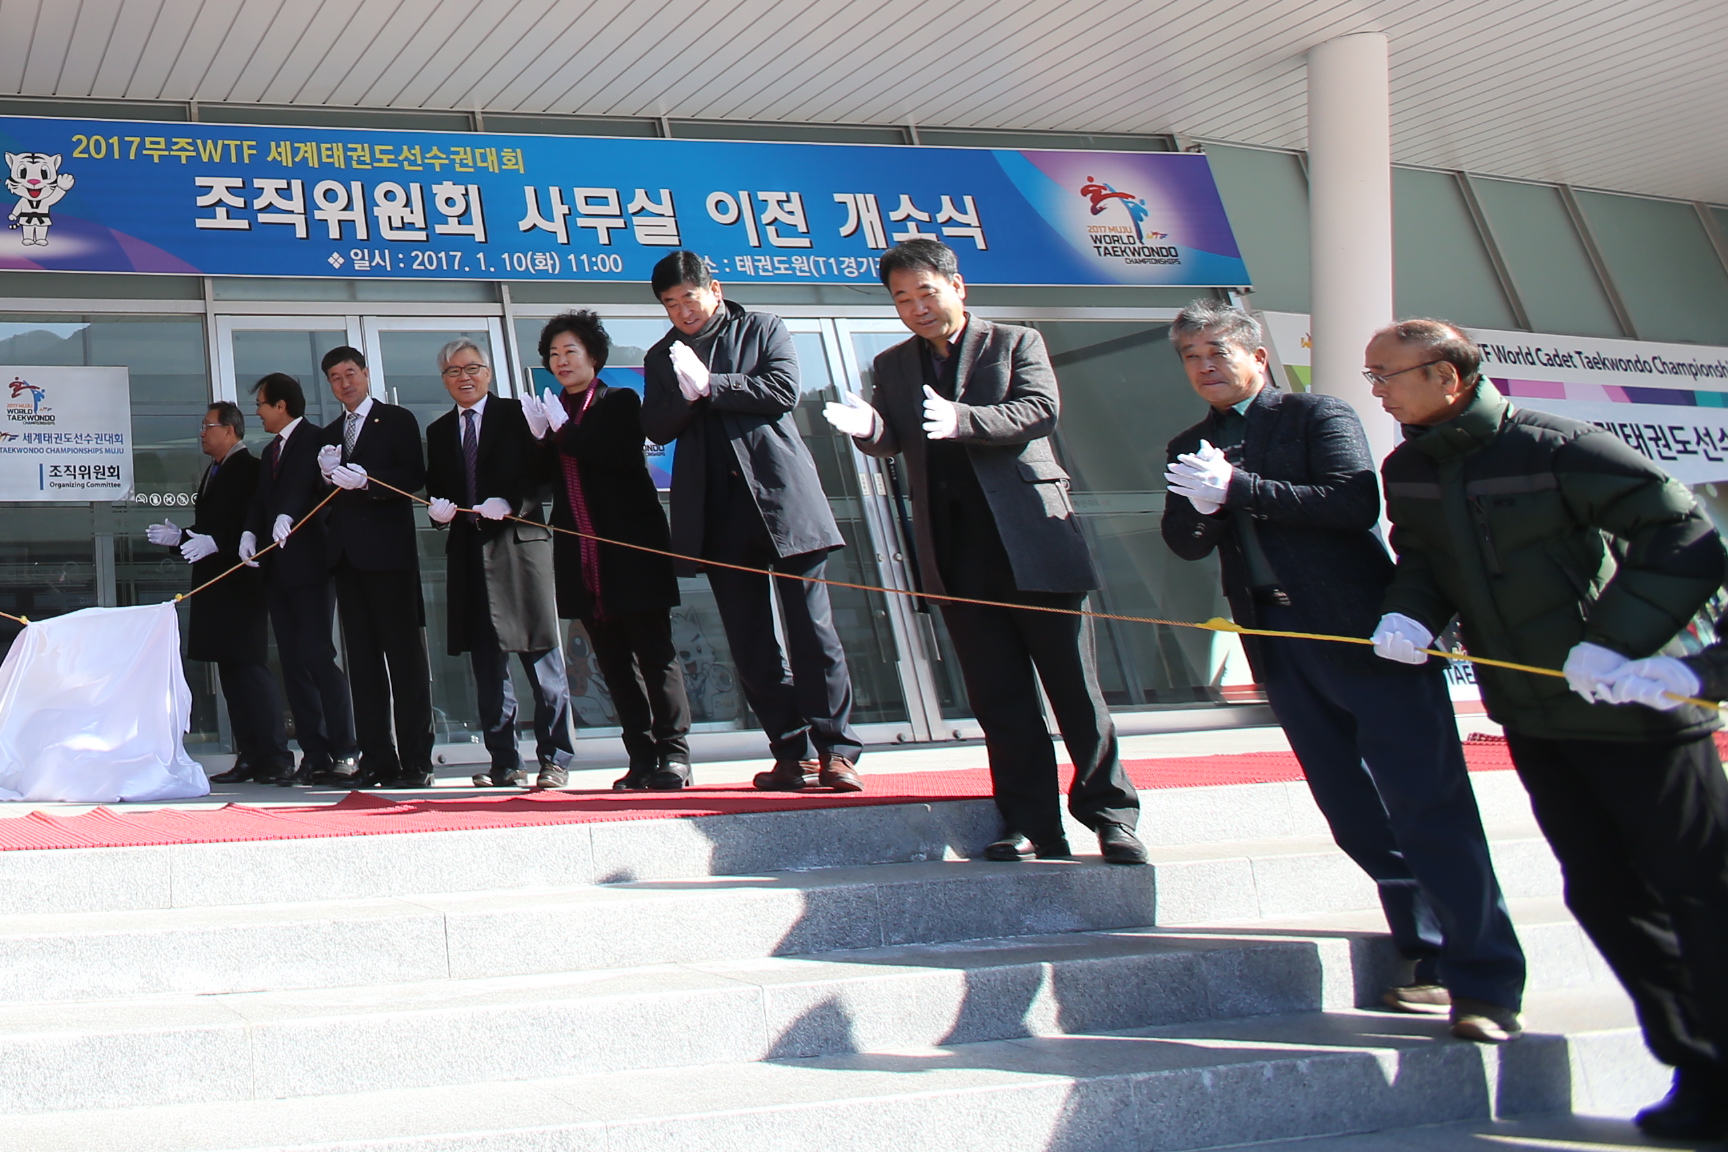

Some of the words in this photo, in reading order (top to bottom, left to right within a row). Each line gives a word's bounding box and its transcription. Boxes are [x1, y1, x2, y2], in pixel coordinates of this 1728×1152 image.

[70, 135, 258, 166] 2017무주WTF
[266, 140, 526, 175] 세계태권도선수권대회
[194, 175, 486, 244] 조직위원회
[517, 183, 682, 247] 사무실
[705, 189, 813, 250] 이전
[833, 192, 989, 251] 개소식
[1090, 234, 1136, 245] WORLD
[1093, 245, 1179, 258] TAEKWONDO
[349, 248, 392, 271] 일시
[410, 250, 470, 272] 2017.
[501, 251, 561, 275] 10(화)
[567, 252, 623, 274] 11:00
[734, 255, 881, 278] 태권도원(T1경기
[1492, 343, 1536, 367] World
[1535, 346, 1579, 370] Cadet
[1575, 350, 1654, 375] Taekwondo
[1651, 355, 1728, 382] Championsh
[7, 414, 56, 422] TAEKWONDO
[22, 432, 124, 445] 세계태권도선수권대회
[0, 446, 45, 454] TAEKWONDO
[45, 447, 104, 455] CHAMPIONSHIPS
[104, 447, 125, 455] MUJU
[48, 464, 121, 480] 조직위원회
[49, 481, 85, 490] Organizing
[86, 481, 122, 489] Committee
